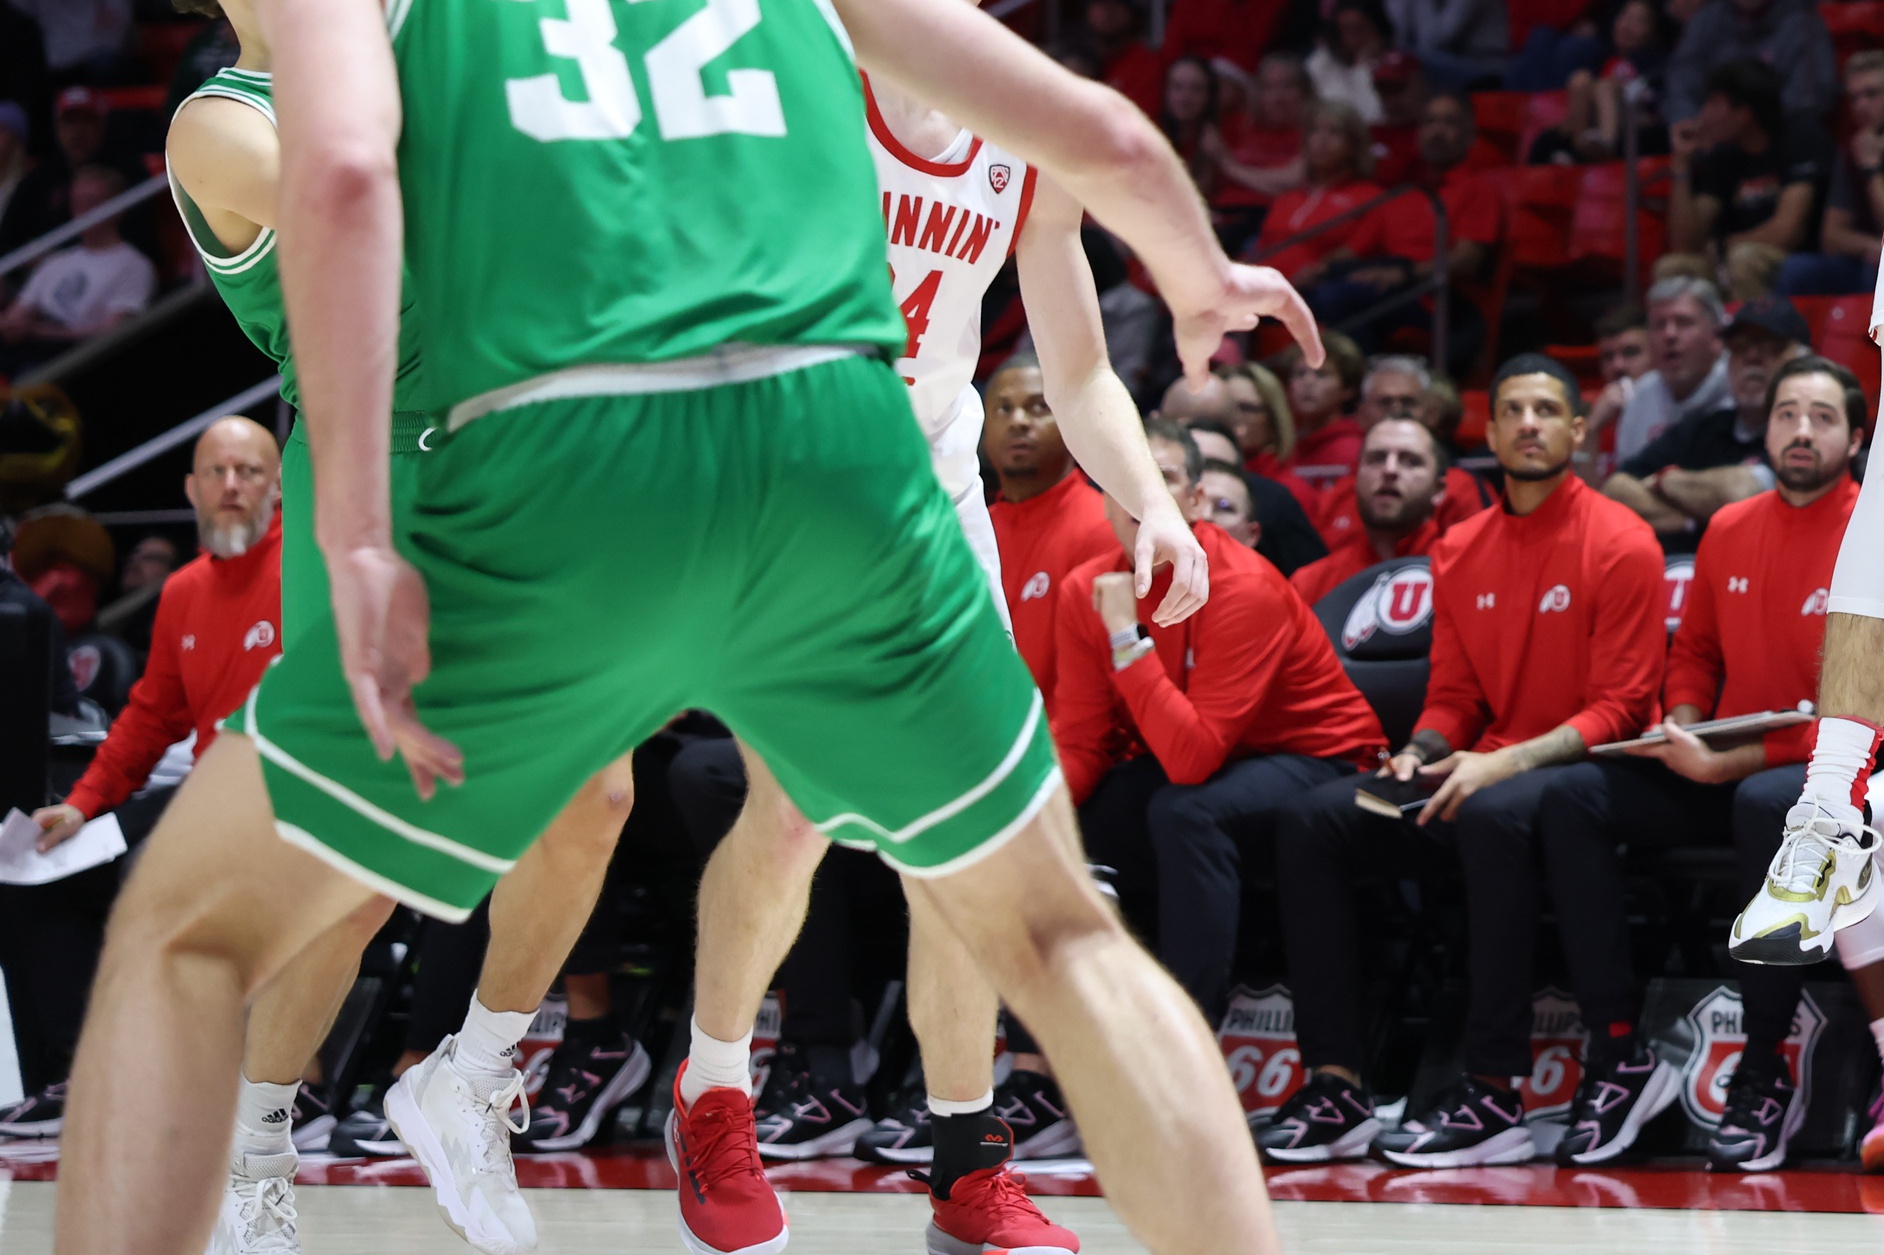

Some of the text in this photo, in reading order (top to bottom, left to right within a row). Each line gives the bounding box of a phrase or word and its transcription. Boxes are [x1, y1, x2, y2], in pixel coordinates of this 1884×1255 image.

[882, 191, 1001, 265] NNIN'
[1389, 583, 1427, 622] U
[1226, 1008, 1294, 1033] PHILLI
[1226, 1045, 1300, 1097] 66
[1531, 1047, 1571, 1095] 6
